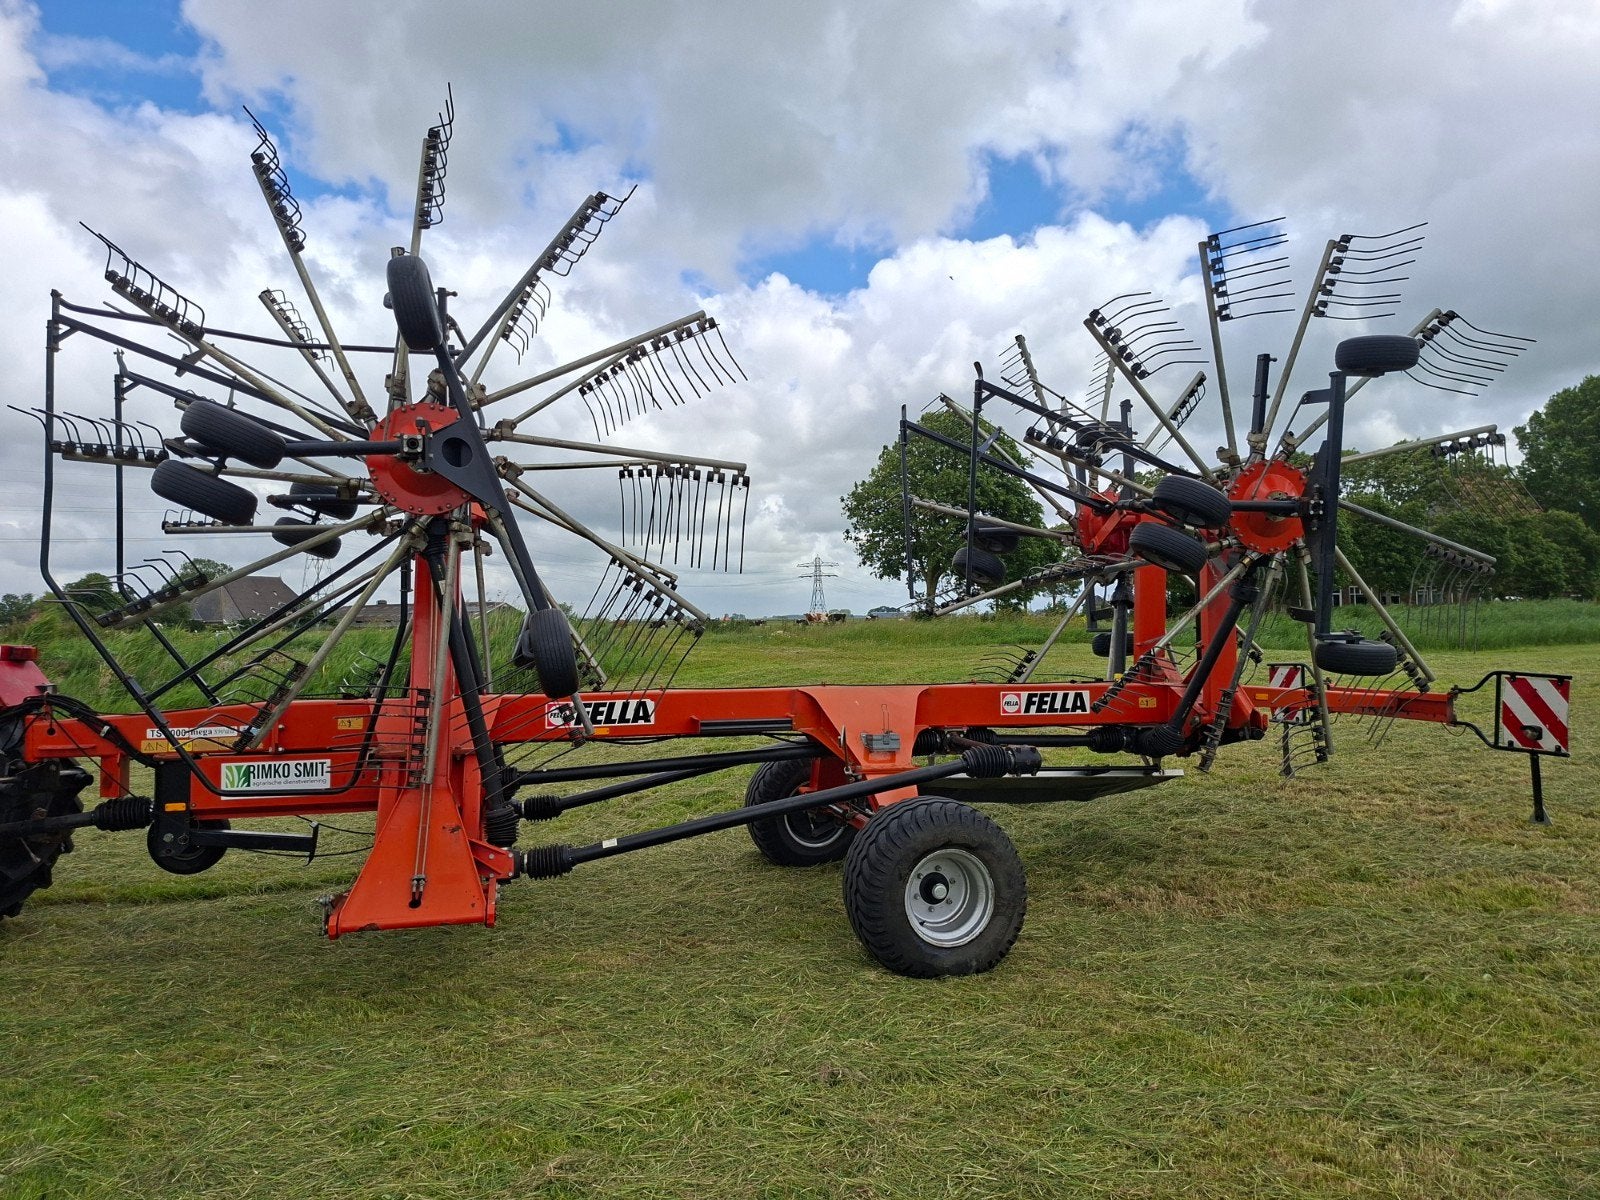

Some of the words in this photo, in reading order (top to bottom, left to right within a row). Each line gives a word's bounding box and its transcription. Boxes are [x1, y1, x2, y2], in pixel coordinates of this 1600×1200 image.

[1024, 692, 1087, 714] FELLA
[249, 763, 290, 779] RIMKO
[294, 761, 327, 778] SMIT
